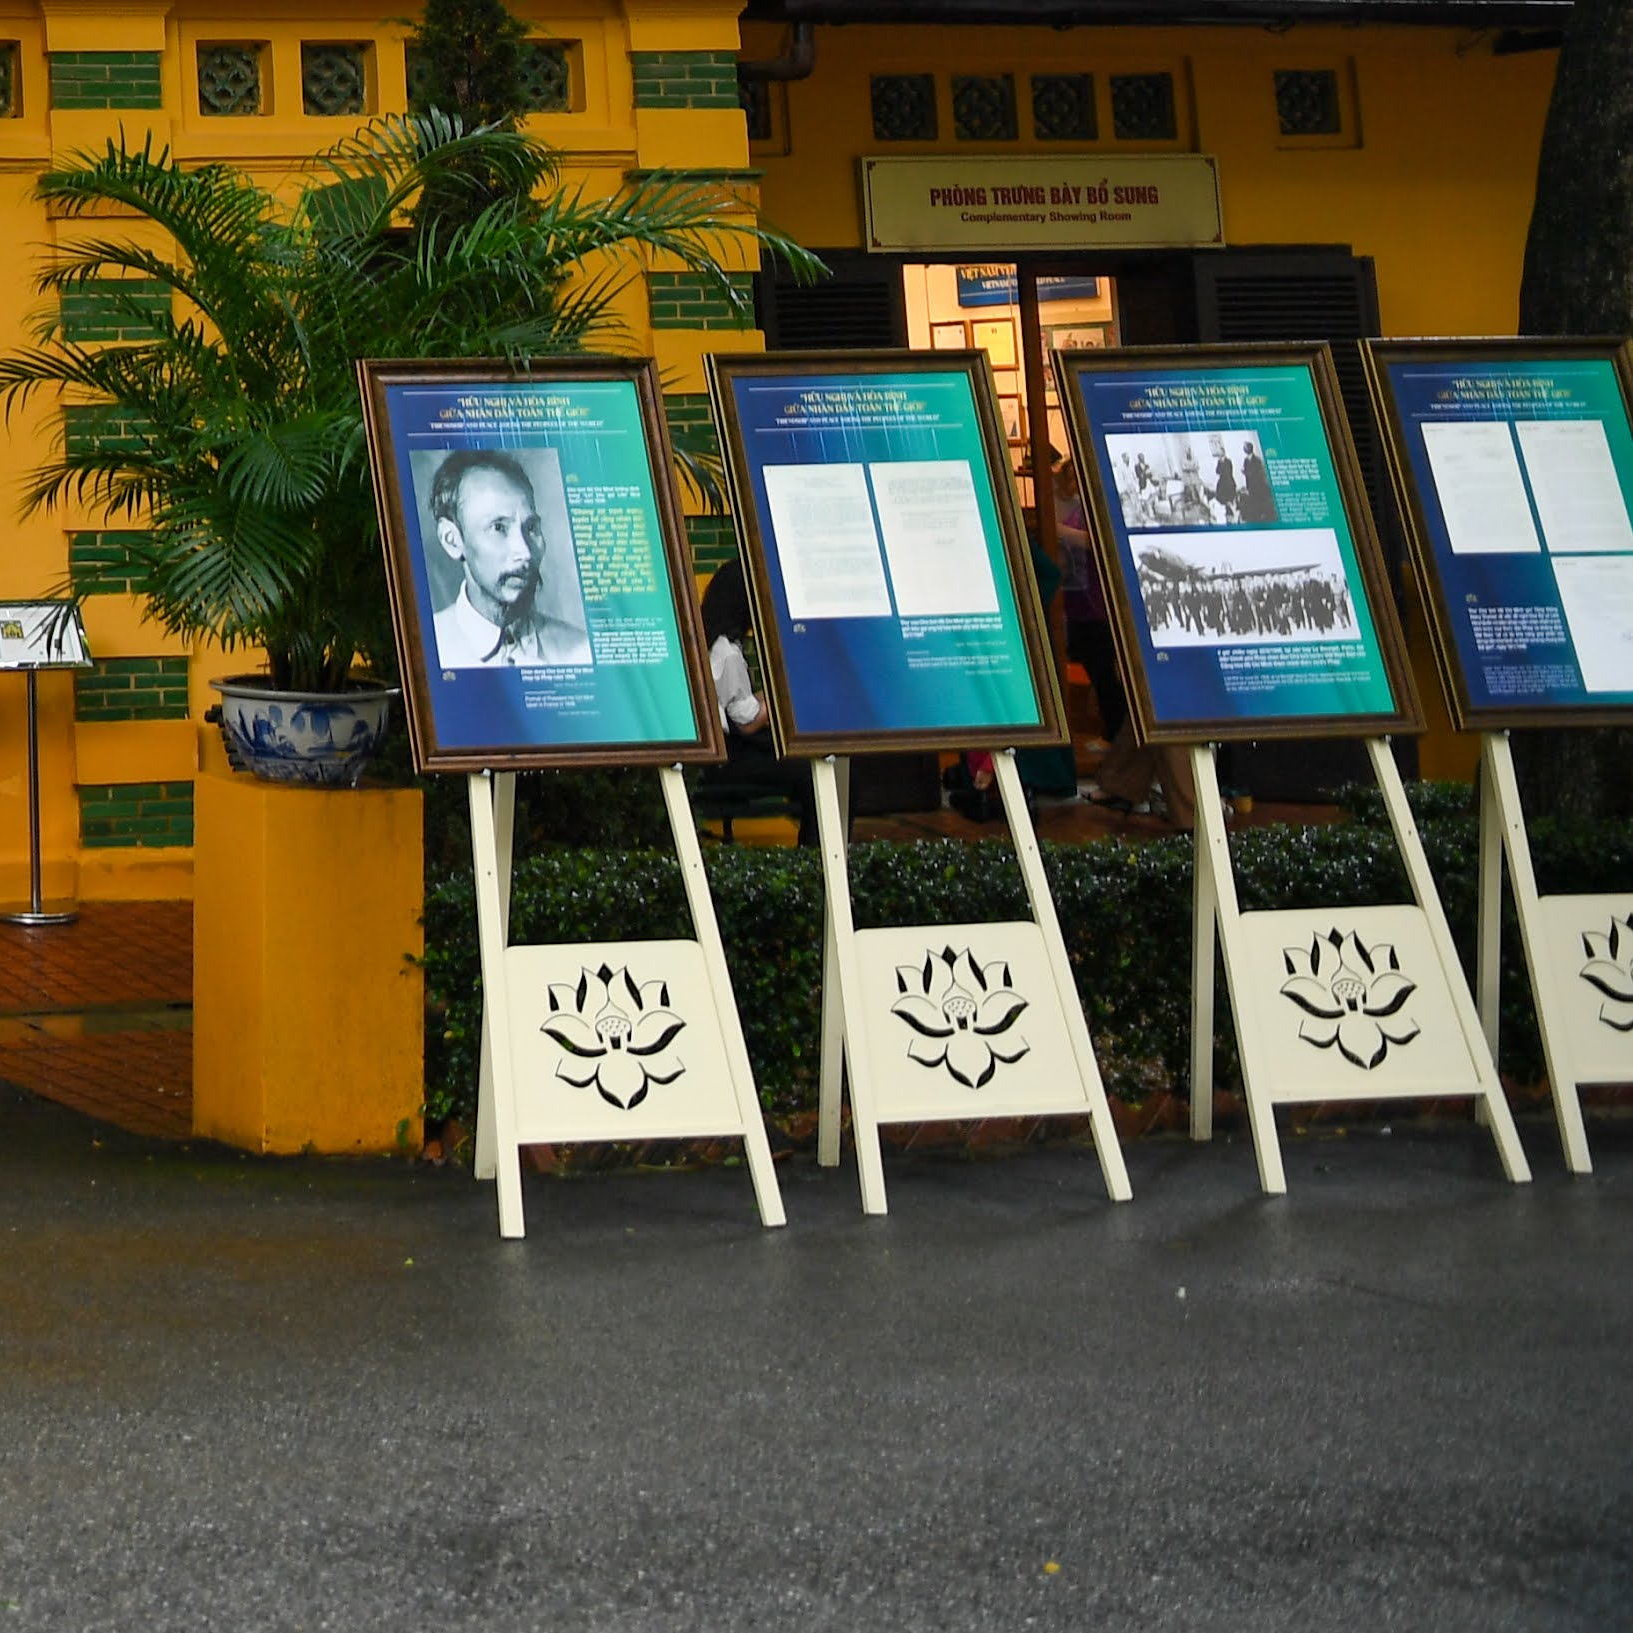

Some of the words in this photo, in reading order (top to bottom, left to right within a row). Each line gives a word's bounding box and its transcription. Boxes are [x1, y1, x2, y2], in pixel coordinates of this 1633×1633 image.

[930, 184, 988, 206] PHÒNG
[991, 185, 1046, 205] TRƯNG
[1050, 182, 1081, 205] BÀY
[1087, 179, 1110, 205] BỔ
[1114, 186, 1159, 205] SUNG
[961, 212, 1045, 224] Complementary
[1049, 212, 1096, 223] Showing
[1099, 210, 1132, 221] Room
